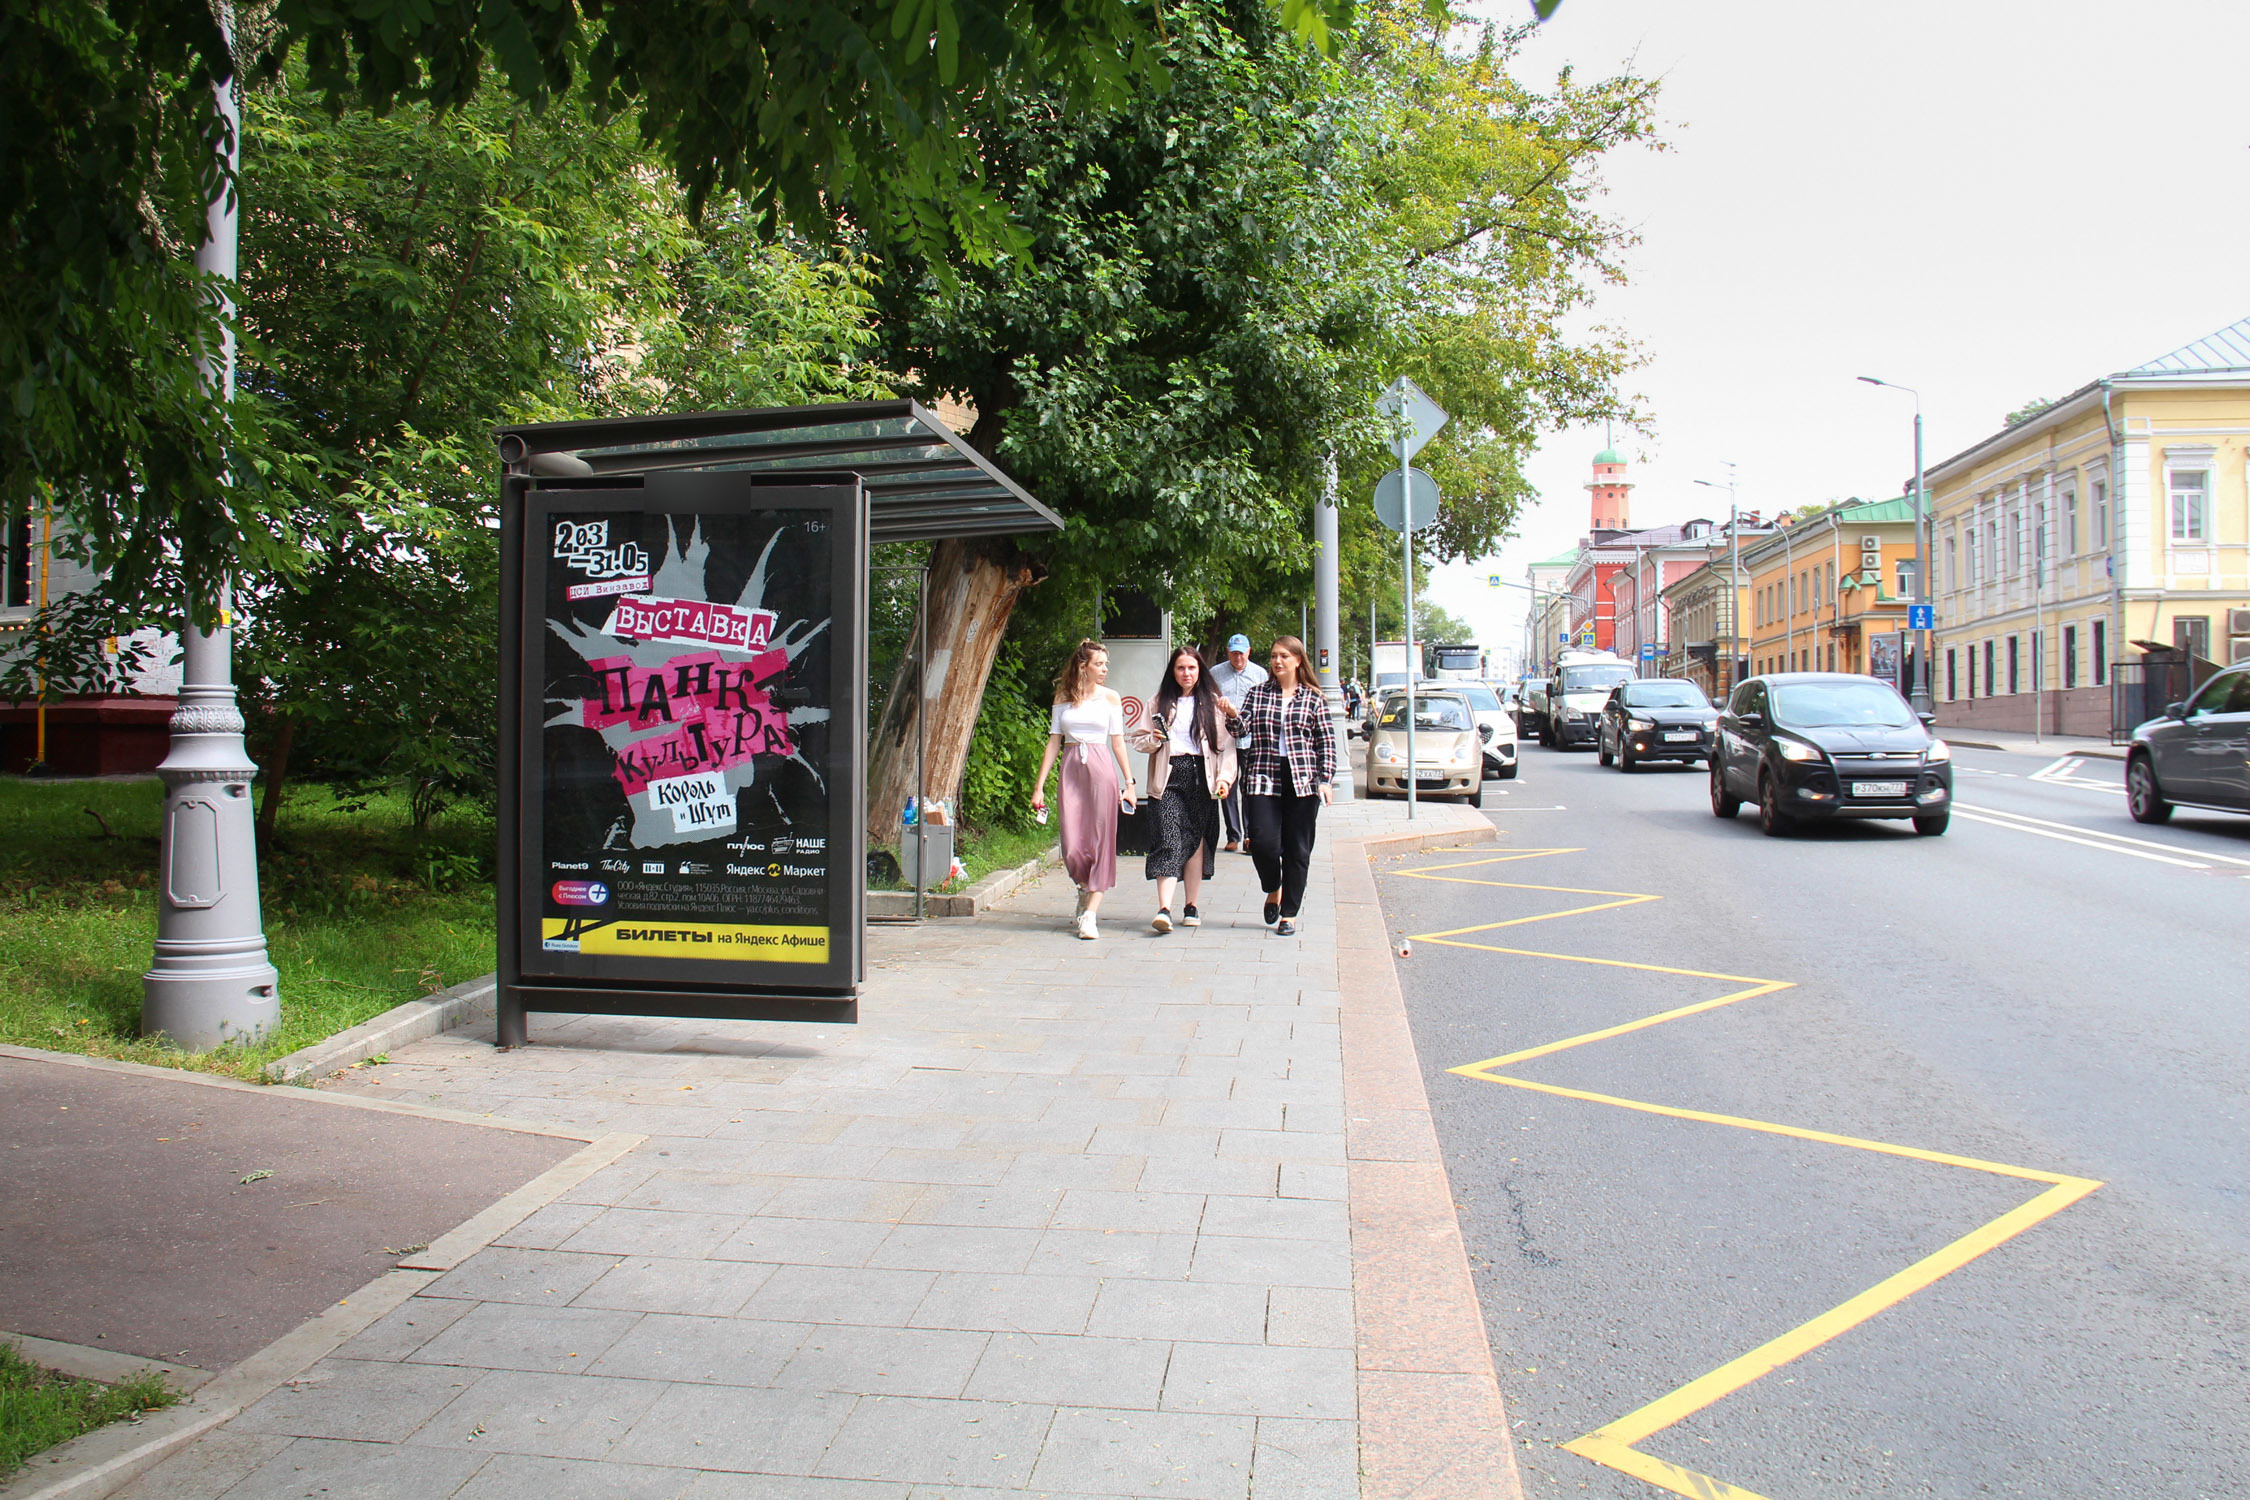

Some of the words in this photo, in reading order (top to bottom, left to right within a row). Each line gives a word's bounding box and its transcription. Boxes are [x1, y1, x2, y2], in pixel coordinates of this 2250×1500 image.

[804, 521, 826, 533] 16+
[558, 523, 603, 554] 2.03
[570, 586, 590, 598] ЦСИ
[596, 581, 649, 594] Винзавод
[617, 605, 768, 646] ВЫСТАВКА
[680, 812, 686, 820] и
[796, 838, 827, 849] НАШЕ
[551, 861, 589, 870] Planet9
[726, 863, 766, 877] Яндекс
[783, 865, 827, 878] Маркет
[558, 885, 587, 893] Выгоднее
[617, 881, 634, 891] ООО
[616, 928, 713, 943] БИЛЕТЫ
[718, 935, 733, 943] на
[735, 933, 779, 946] Яндекс
[781, 934, 826, 947] Афише
